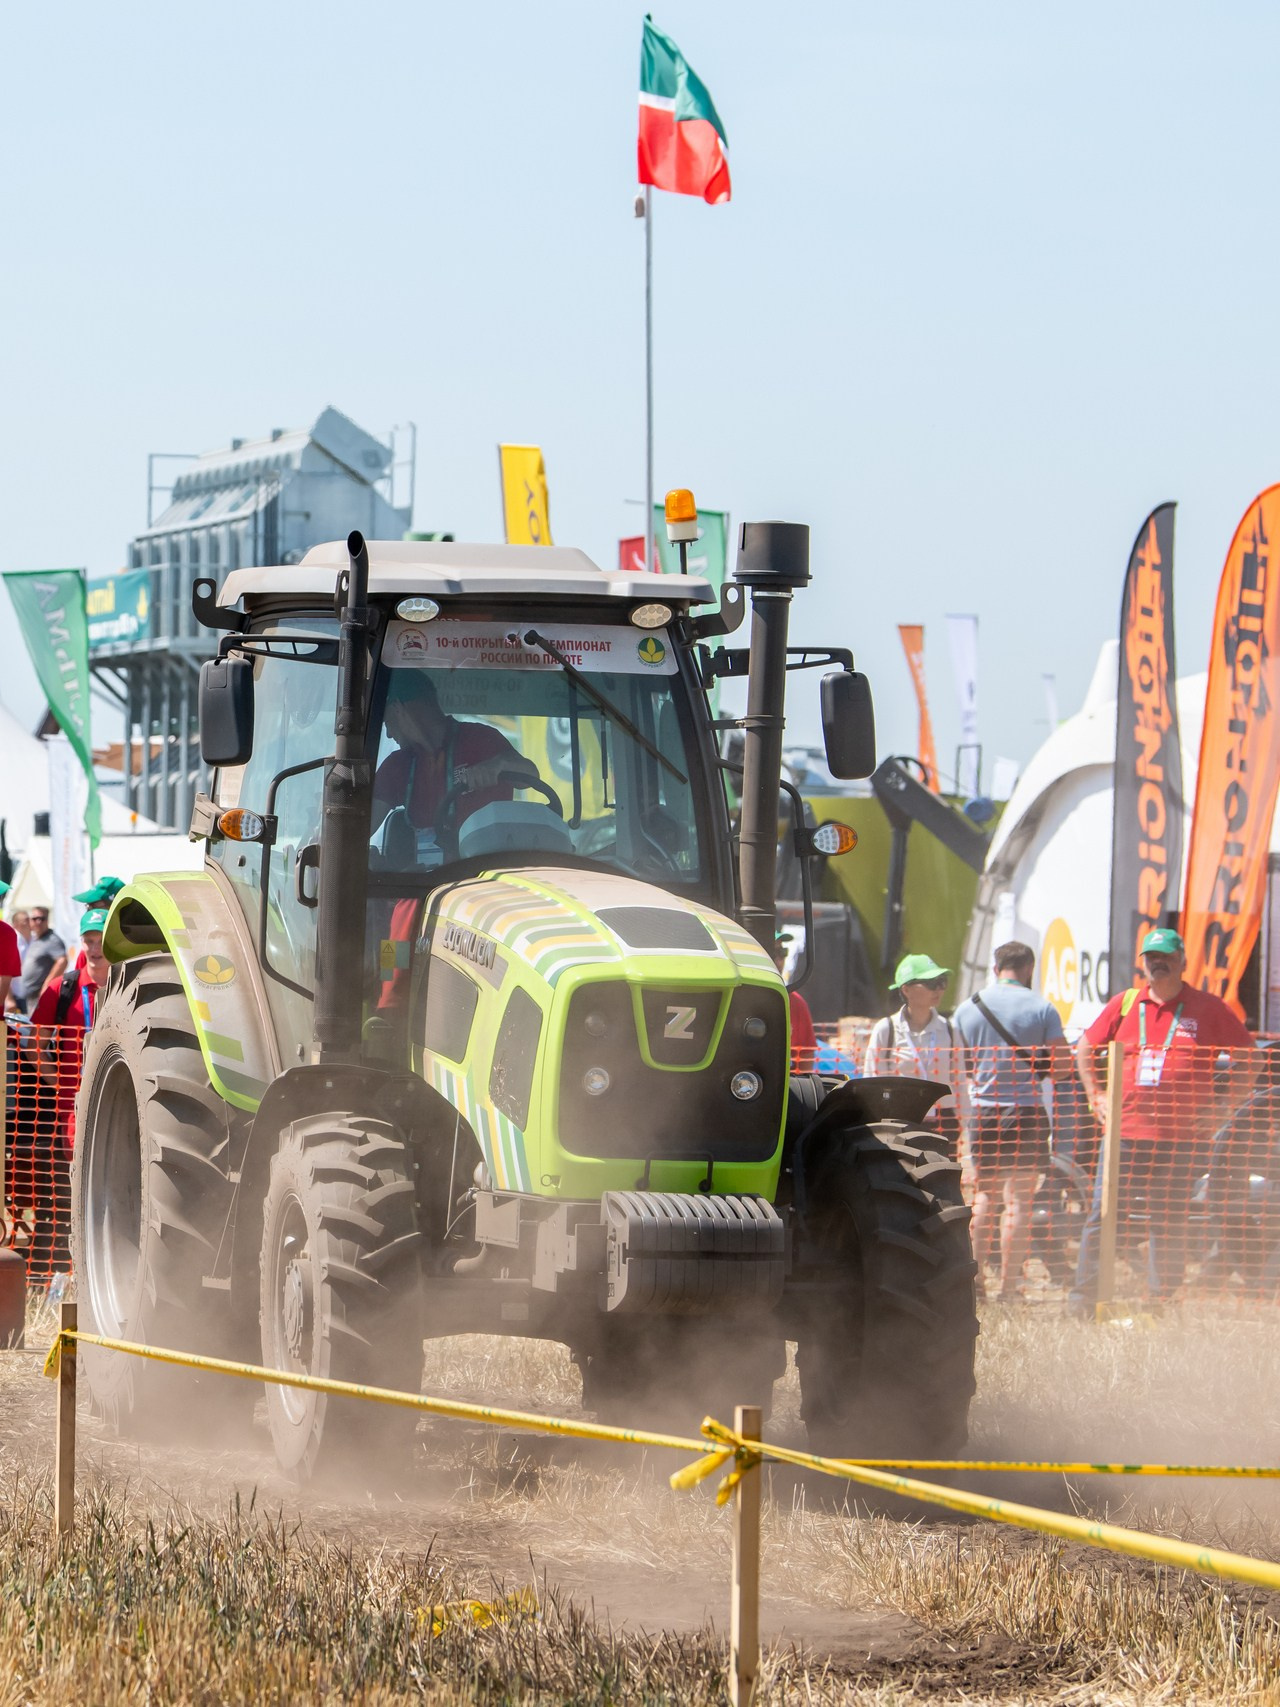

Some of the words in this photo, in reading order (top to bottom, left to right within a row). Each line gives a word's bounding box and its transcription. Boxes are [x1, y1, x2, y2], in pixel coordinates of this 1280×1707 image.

[436, 636, 459, 648] 10-й
[546, 639, 611, 652] ЕМПИОНАТ
[480, 652, 520, 664] РОССИИ
[525, 653, 540, 665] ПО
[443, 920, 497, 970] ZOOMLION
